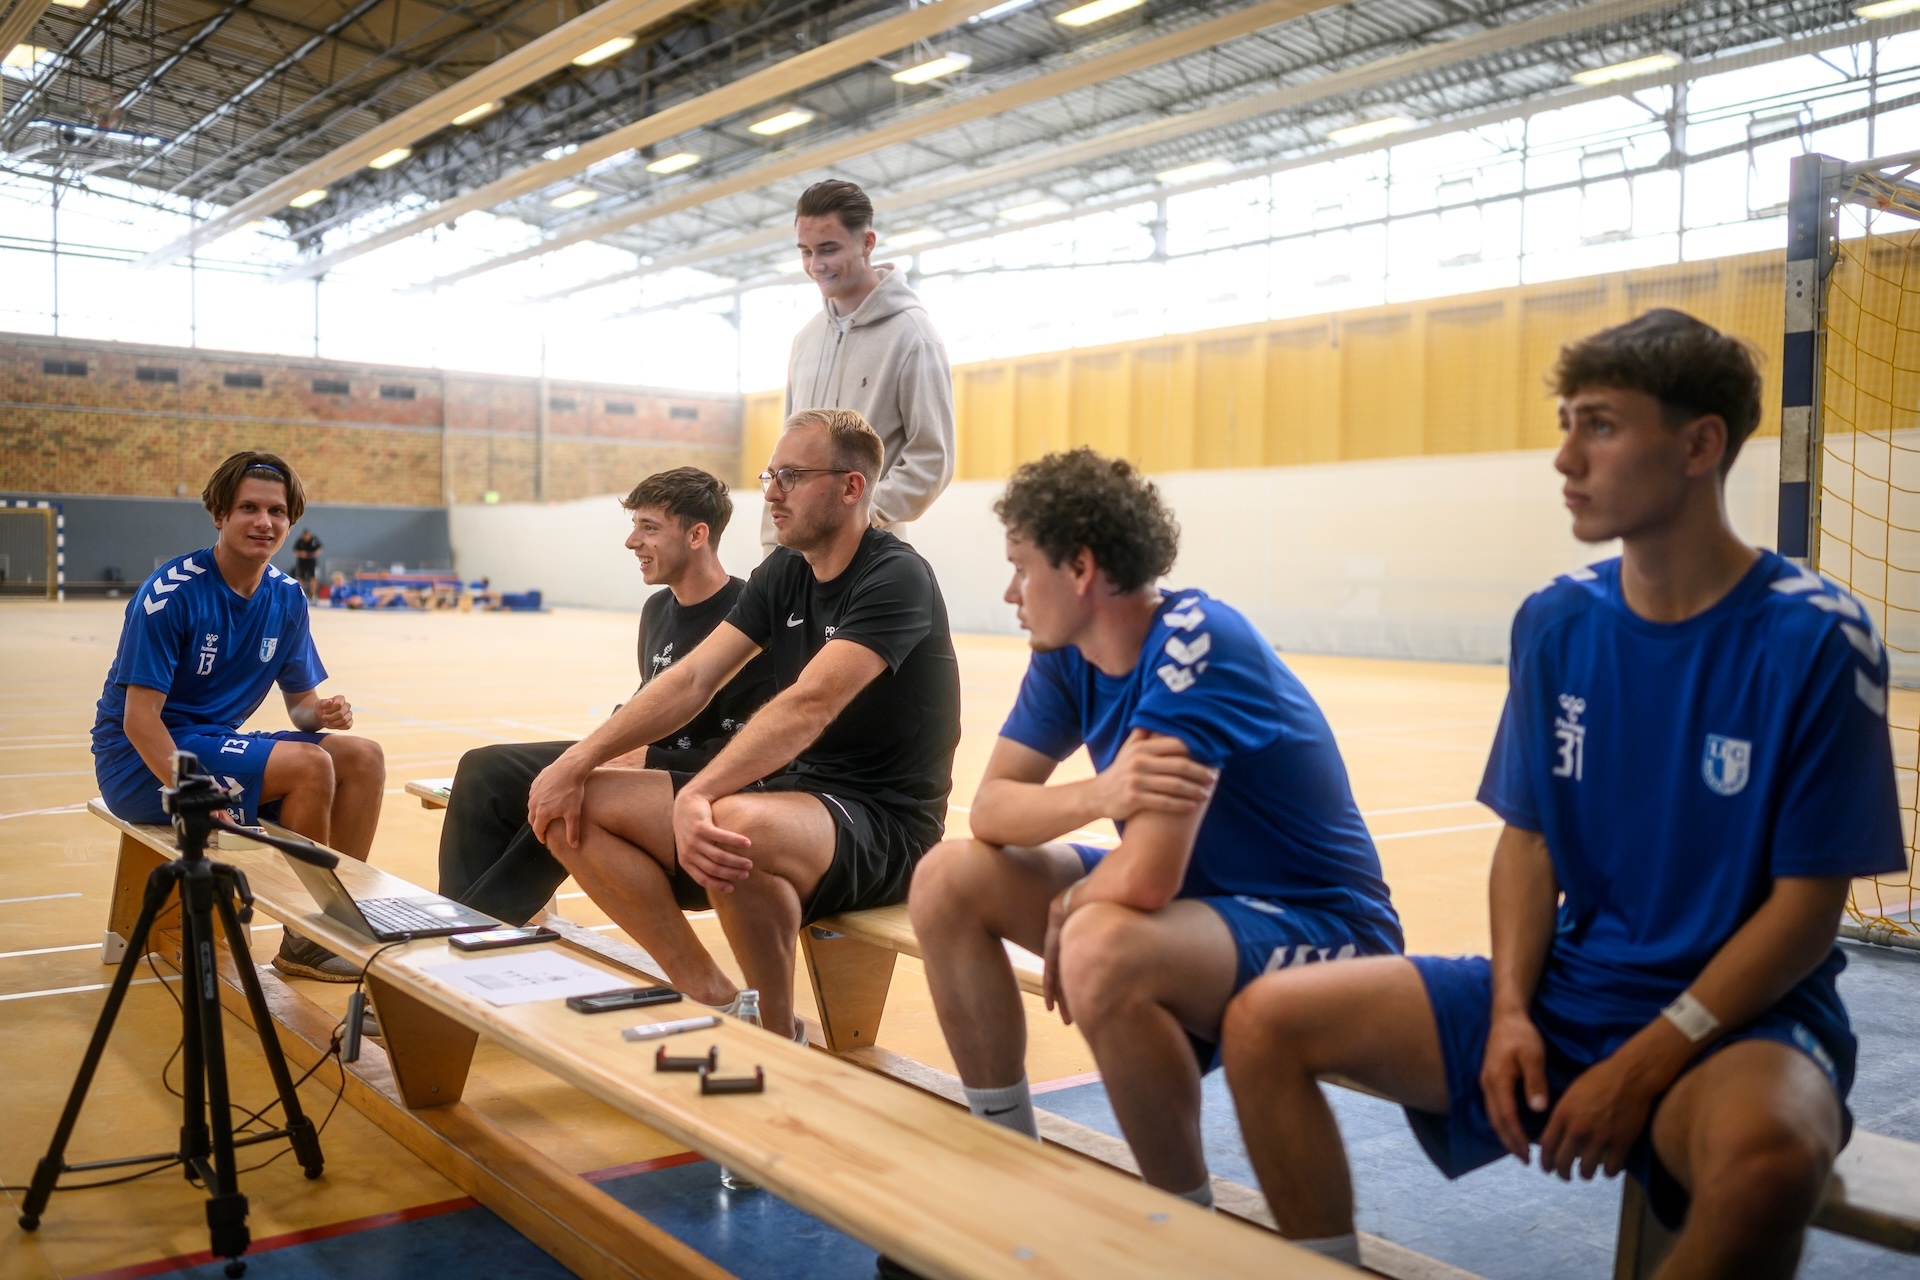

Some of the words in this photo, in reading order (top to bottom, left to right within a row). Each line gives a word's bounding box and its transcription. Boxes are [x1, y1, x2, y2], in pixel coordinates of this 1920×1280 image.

[825, 625, 840, 636] PR
[196, 652, 216, 676] 13
[220, 738, 250, 755] 13
[1551, 729, 1584, 782] 31
